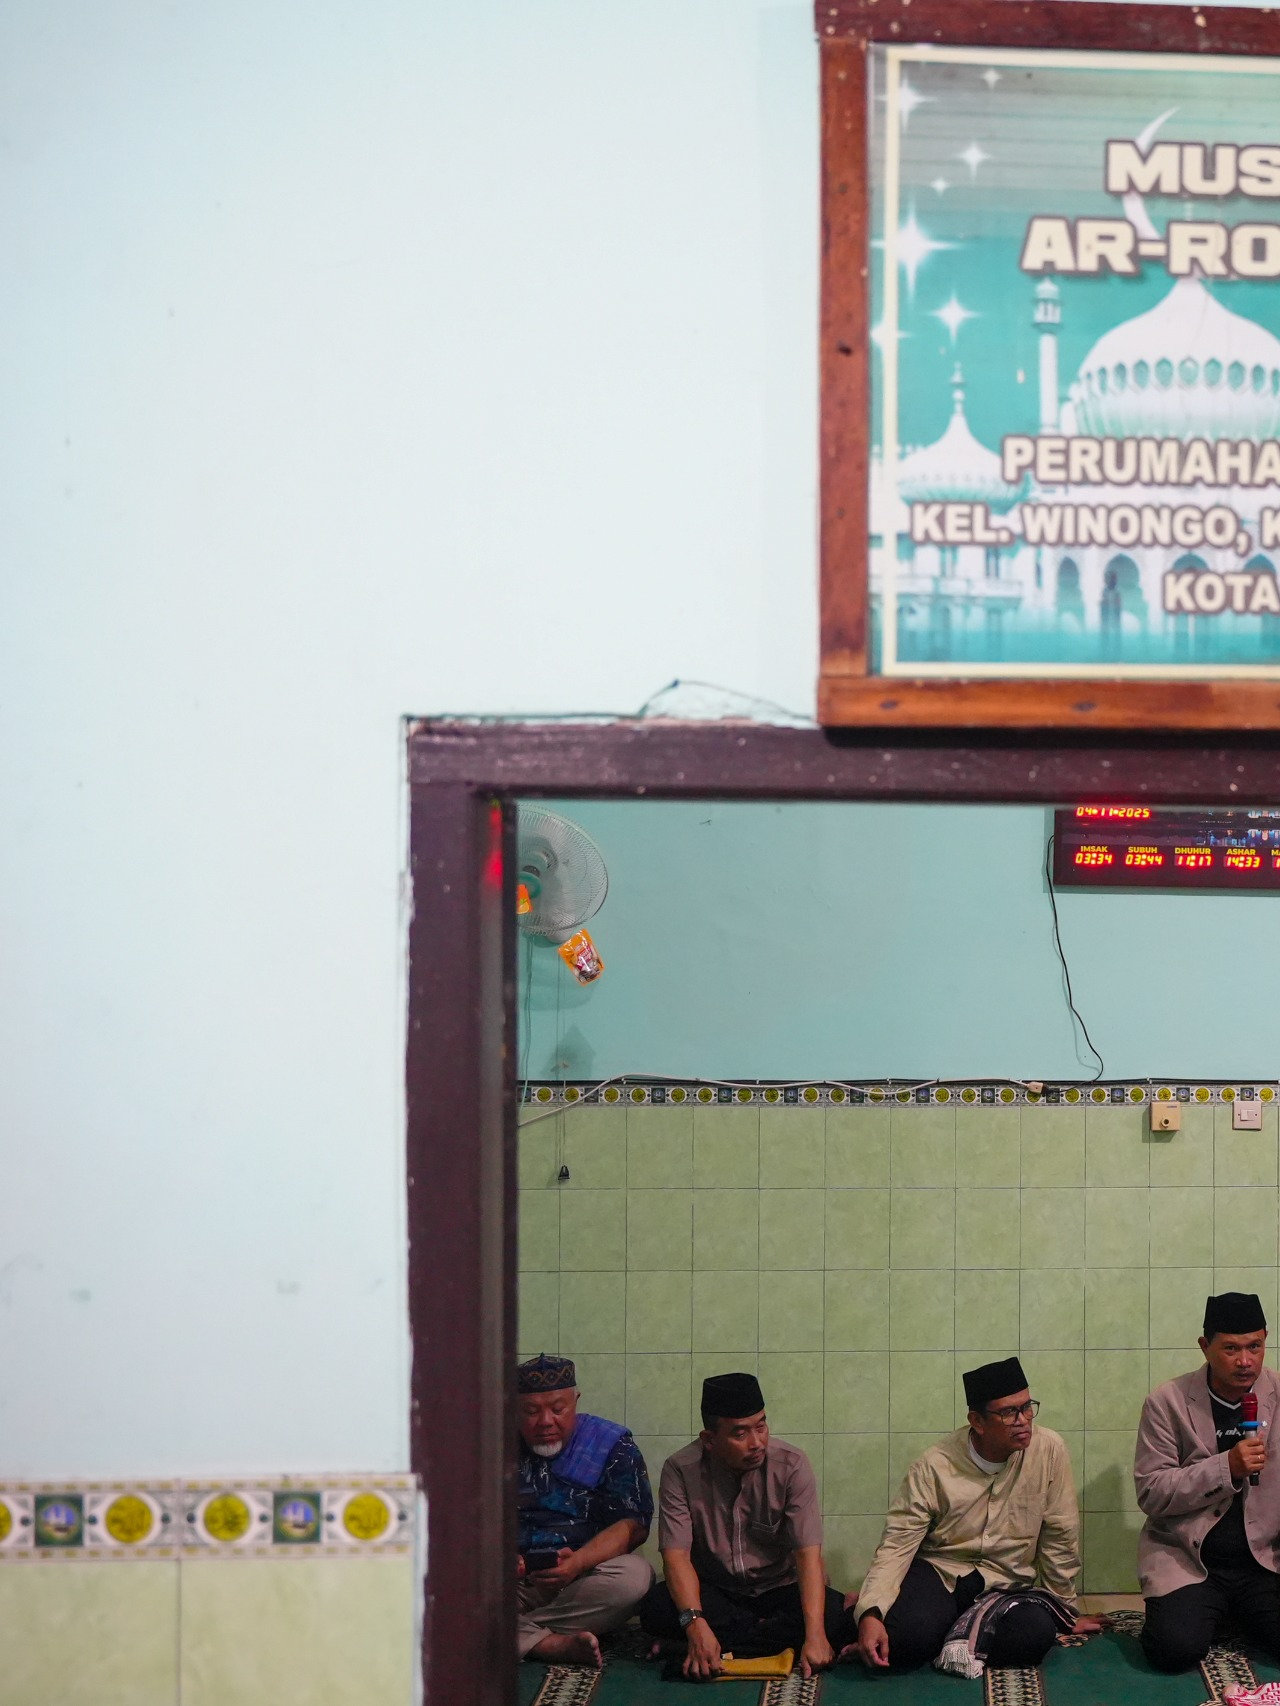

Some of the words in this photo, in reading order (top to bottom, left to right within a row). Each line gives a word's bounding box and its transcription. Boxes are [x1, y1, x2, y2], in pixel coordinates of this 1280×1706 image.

[911, 501, 1014, 545] KEL.
[1018, 503, 1251, 557] WINONGO,
[1080, 845, 1109, 853] IMSAK
[1127, 846, 1158, 854] SUBUH
[1174, 847, 1212, 855] DHUHUR
[1226, 848, 1256, 856] ASHAR
[1075, 853, 1113, 865] 03:34
[1125, 854, 1163, 866] 03:44
[1177, 855, 1212, 867] 11:17
[1226, 856, 1261, 868] 14:33
